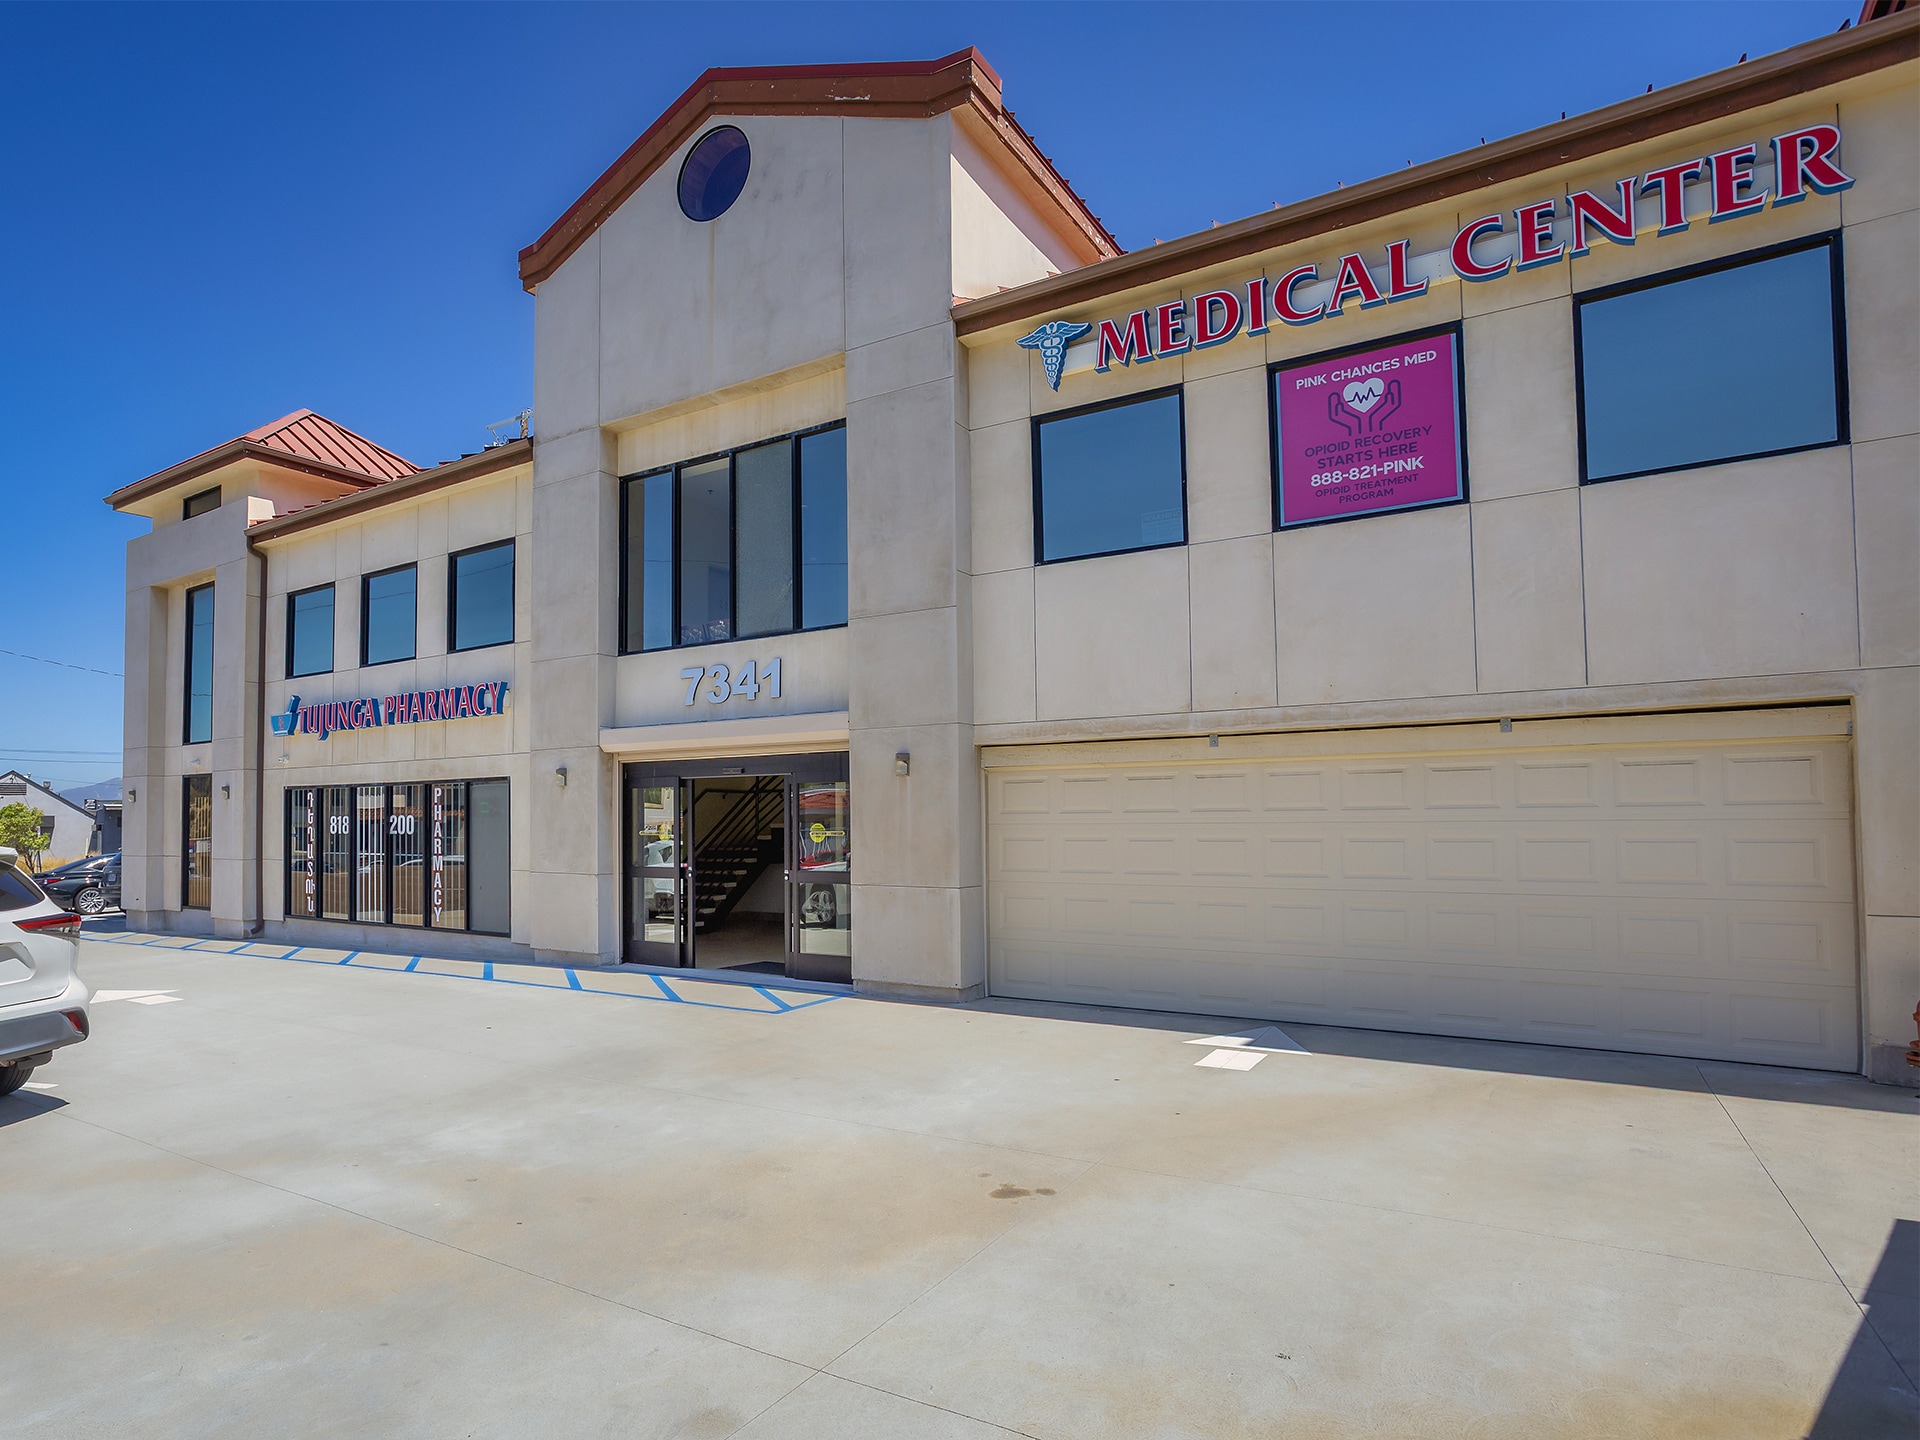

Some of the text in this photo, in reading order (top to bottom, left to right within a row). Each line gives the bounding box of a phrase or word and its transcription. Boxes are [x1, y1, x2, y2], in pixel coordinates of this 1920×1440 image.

[1094, 123, 1856, 373] MEDICAL CENTER
[1295, 350, 1437, 390] PINK CHANCES MED
[1304, 424, 1433, 457] OPIOID RECOVERY
[1317, 441, 1418, 469] STARTS HERE
[1310, 456, 1424, 487] 888-821-PINK
[1315, 473, 1419, 498] OPIOID TREATMENT
[1338, 487, 1394, 504] PROGRAM
[680, 657, 782, 706] 7341
[298, 681, 508, 740] TUJUNGA PHARMACY
[329, 814, 415, 835] 818 200
[432, 787, 444, 923] PHARMACY
